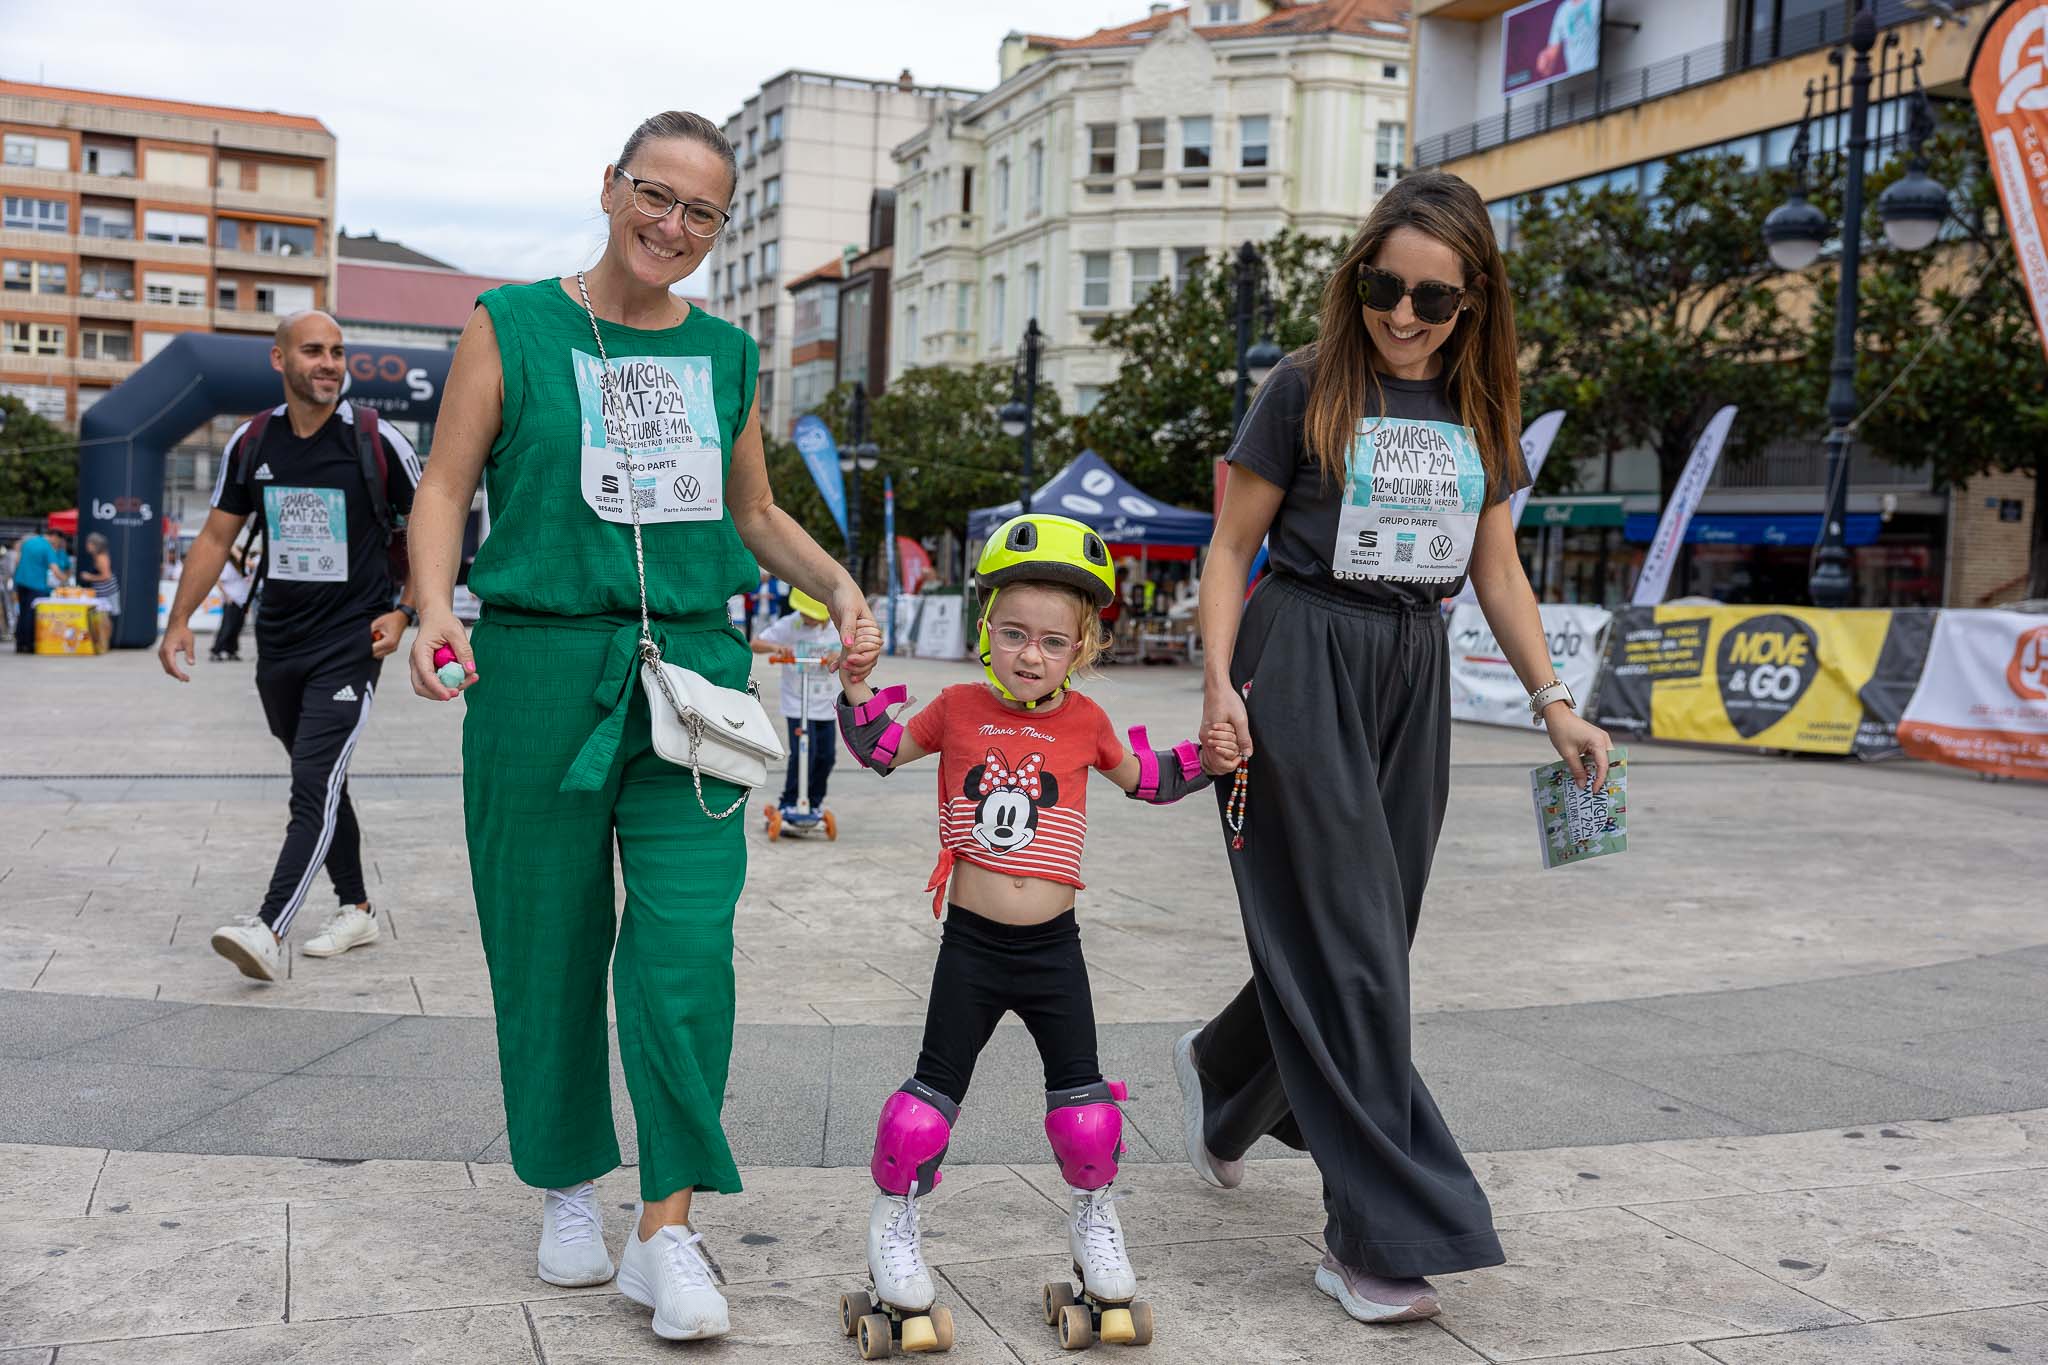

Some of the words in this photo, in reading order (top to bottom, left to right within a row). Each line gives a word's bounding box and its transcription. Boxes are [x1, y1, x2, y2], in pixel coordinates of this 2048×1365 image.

[607, 363, 679, 393] MARCHA
[655, 391, 686, 415] 2024
[604, 419, 616, 436] 12
[670, 418, 692, 435] 11h
[1383, 425, 1451, 452] MARCHA
[616, 461, 645, 472] GRUPO
[647, 459, 677, 471] PARTE
[1372, 448, 1424, 475] AMAT
[1428, 451, 1457, 477] 2024
[1371, 477, 1385, 493] 12
[1392, 477, 1433, 497] OCTUBRE
[1440, 480, 1458, 498] 11h
[595, 495, 625, 504] SEAT
[598, 504, 623, 513] BESAUTO
[1378, 516, 1410, 526] GRUPO
[1410, 518, 1438, 527] PARTE
[1351, 558, 1379, 566] BESAUTO
[1728, 631, 1810, 667] MOVE
[1728, 669, 1748, 692] &
[1749, 663, 1801, 701] GO
[979, 724, 1017, 736] Minnie
[1020, 726, 1056, 743] Mouse
